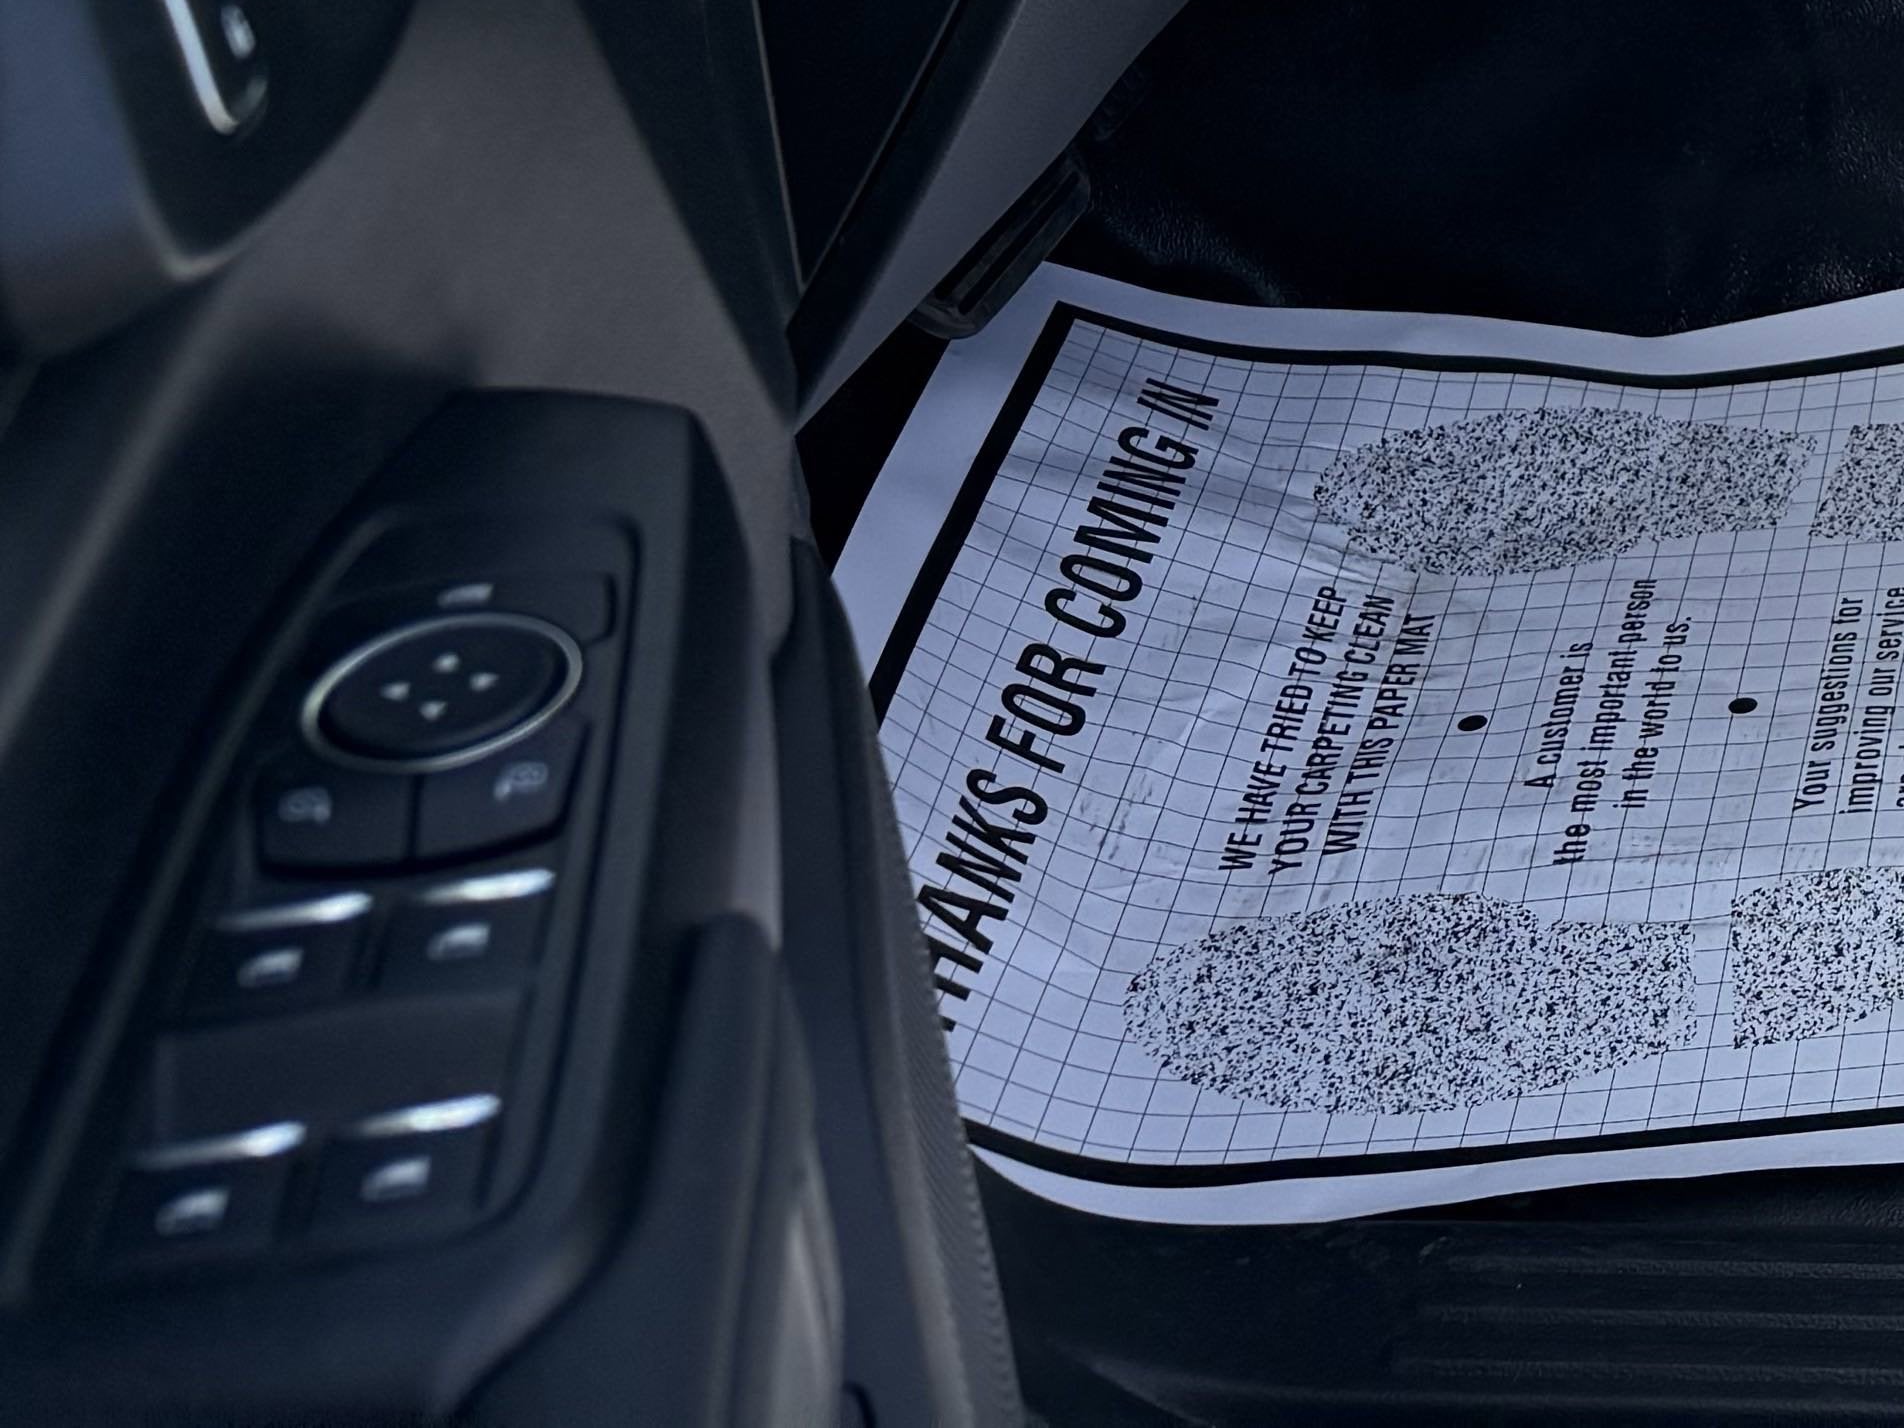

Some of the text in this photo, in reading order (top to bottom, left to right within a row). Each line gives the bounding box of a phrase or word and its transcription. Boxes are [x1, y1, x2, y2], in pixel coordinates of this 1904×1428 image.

[917, 377, 1220, 1032] HANKS FOR COMING IN
[1218, 585, 1348, 871] WE HAVE TRIED TO KEEP
[1268, 593, 1395, 875] YOUR CARPETING CLEAN
[1321, 613, 1436, 856] WITH THIS PAPER MAT
[1524, 641, 1594, 789] A customer is
[1552, 578, 1658, 866] the most important person
[1612, 616, 1693, 809] in the world to us.
[1792, 596, 1864, 813] Your suggestions for
[1838, 704, 1896, 815] improving
[1868, 666, 1898, 698] our
